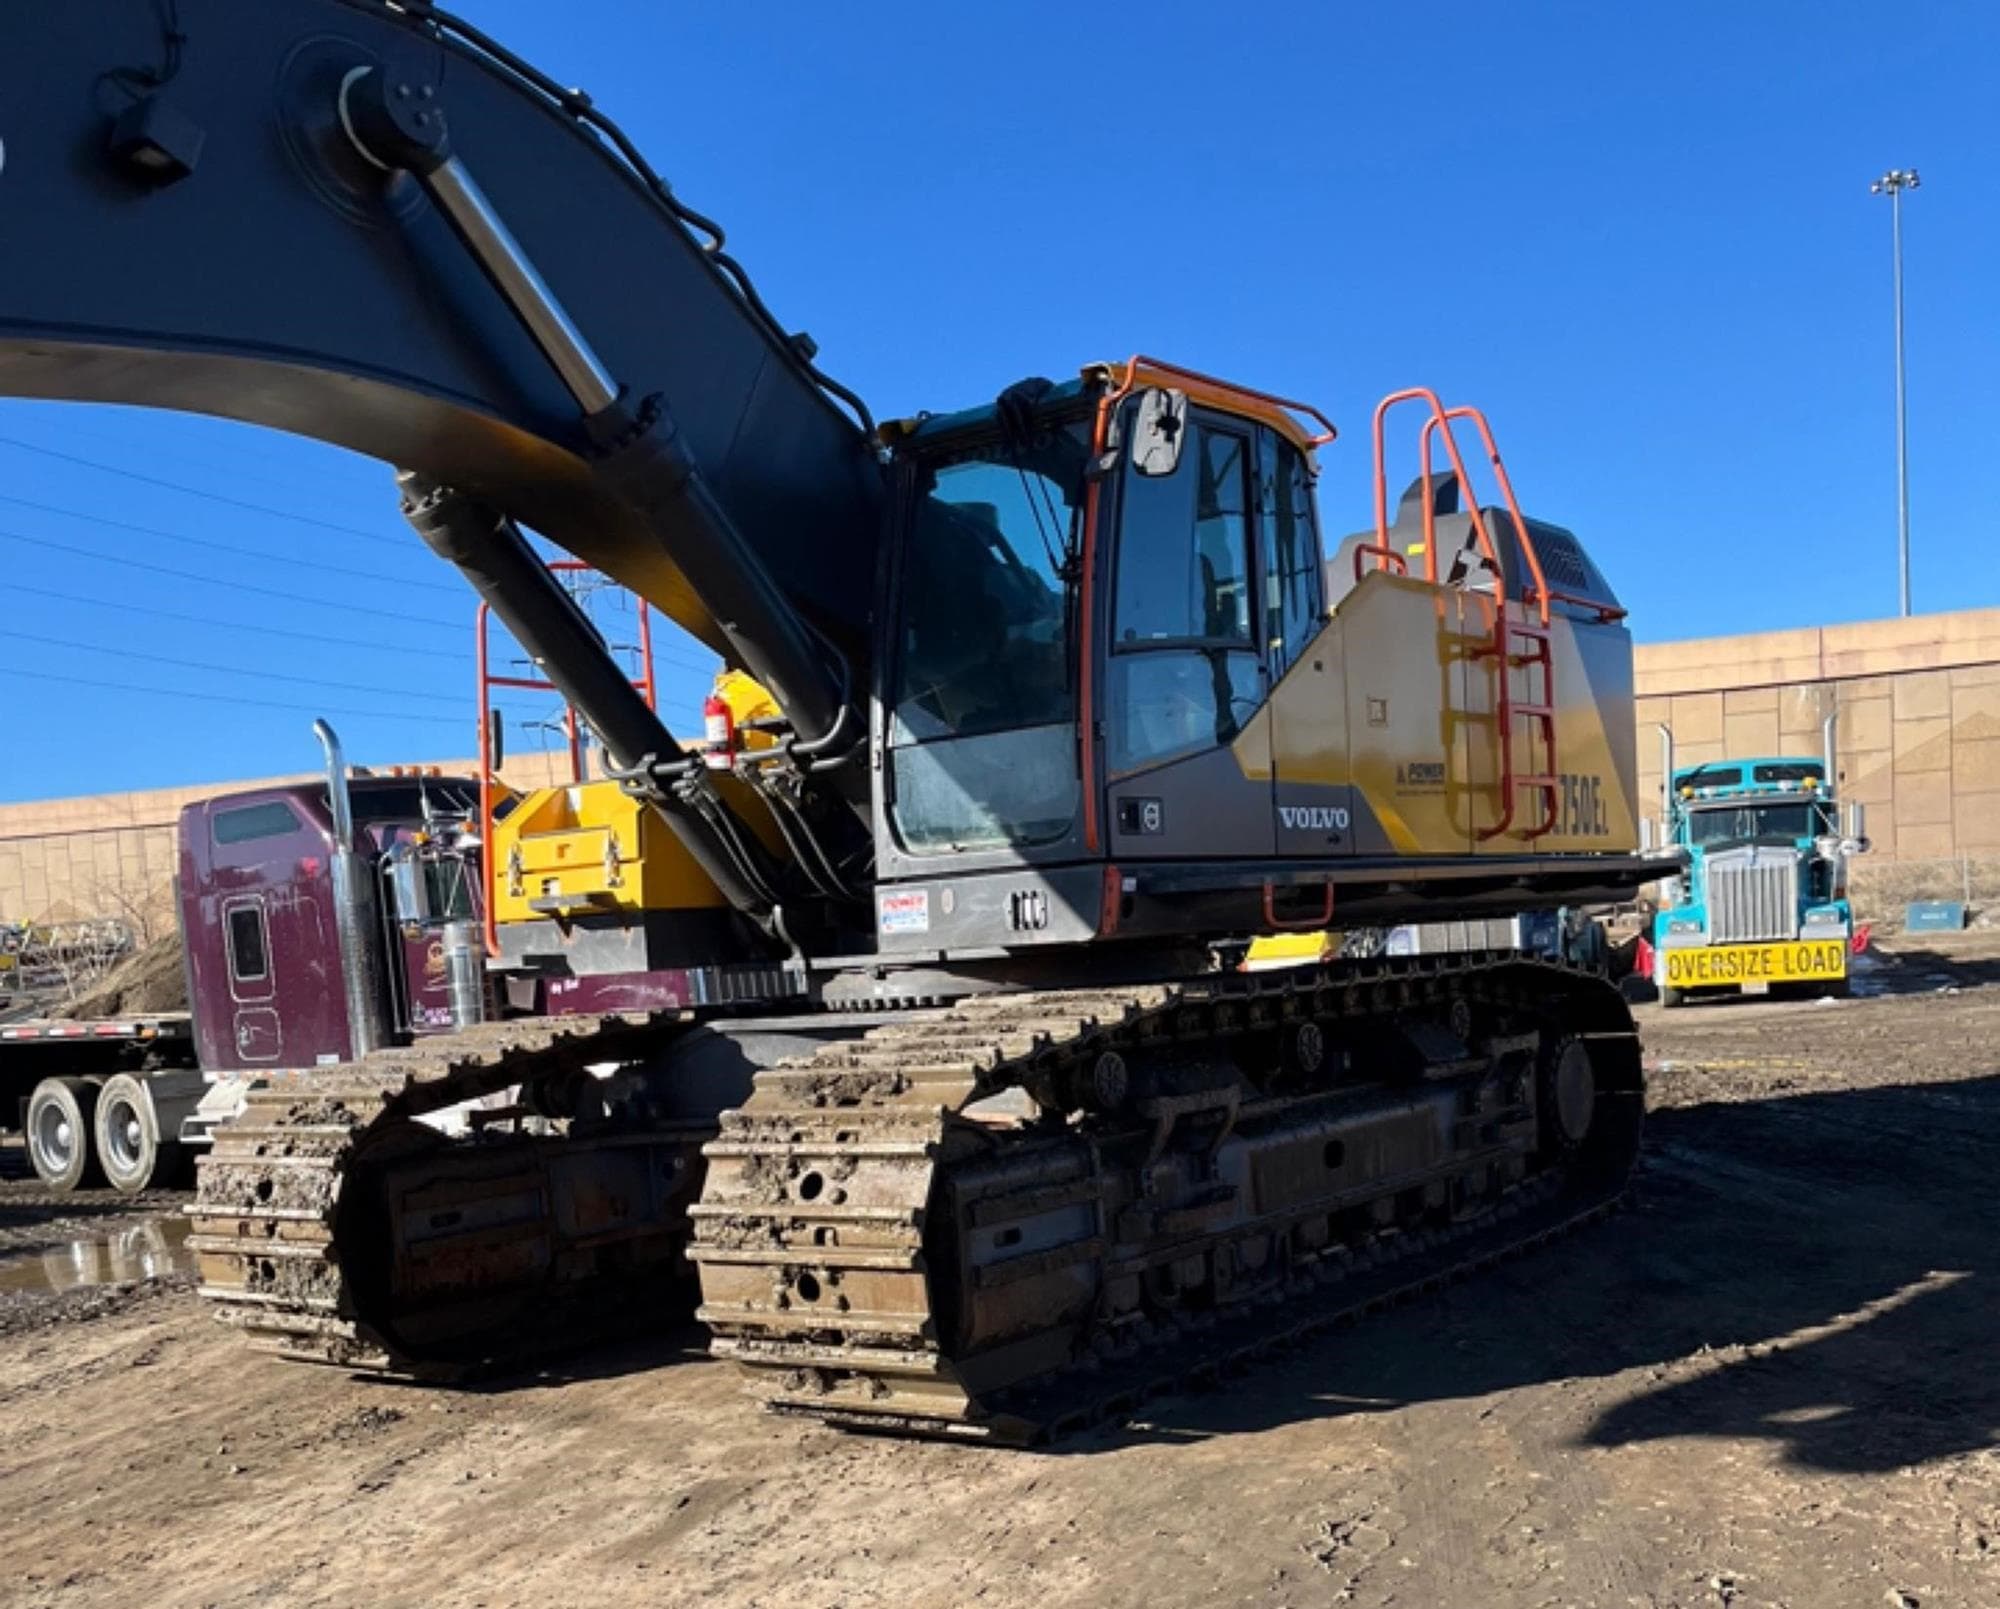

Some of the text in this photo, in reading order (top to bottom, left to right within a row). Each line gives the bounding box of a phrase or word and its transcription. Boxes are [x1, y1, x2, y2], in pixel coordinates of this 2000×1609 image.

[1279, 807, 1348, 828] VOLVO
[1668, 945, 1842, 980] OVERSIZE LOAD
